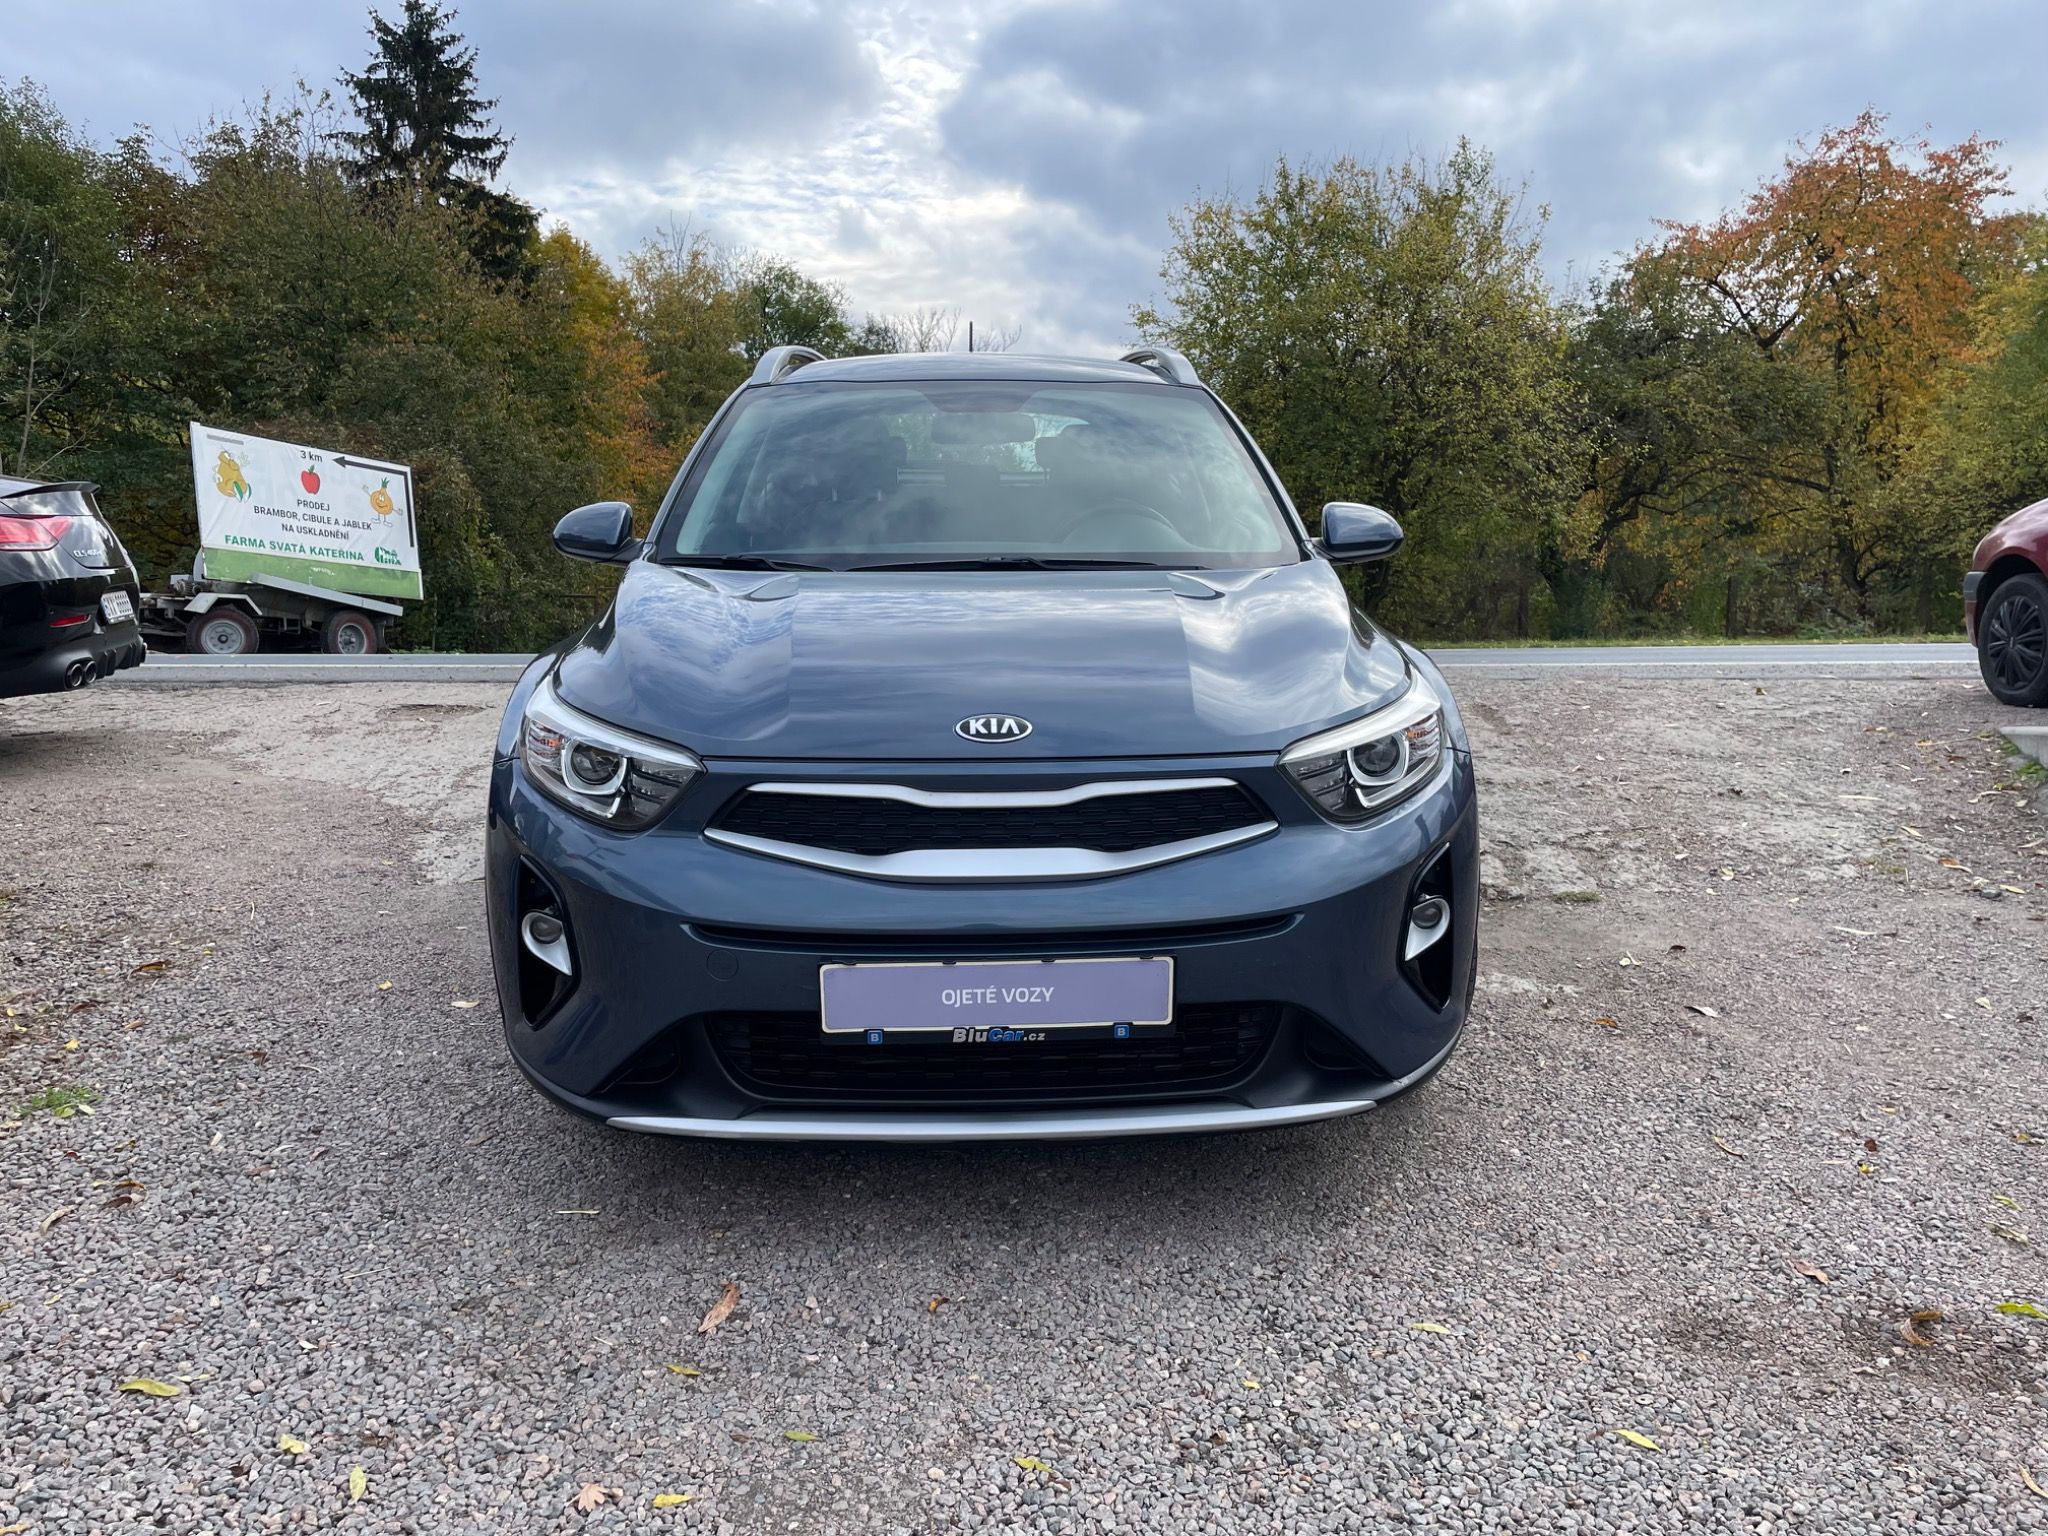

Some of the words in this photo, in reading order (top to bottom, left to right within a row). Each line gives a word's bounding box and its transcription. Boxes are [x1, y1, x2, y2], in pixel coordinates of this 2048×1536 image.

[300, 450, 307, 459] 3
[309, 451, 323, 463] km
[297, 499, 330, 512] PRODEJ
[254, 505, 300, 521] BRAMBOR,
[302, 513, 332, 525] CIBULE
[334, 518, 341, 527] A
[342, 519, 372, 531] JABLEK
[281, 523, 295, 533] NA
[224, 534, 266, 549] FARMA
[269, 540, 307, 555] SVATÁ
[969, 717, 1020, 735] KIA
[941, 985, 998, 1008] OJETÉ
[1001, 986, 1055, 1004] VOZY
[952, 1026, 1046, 1044] BluCar.cz
